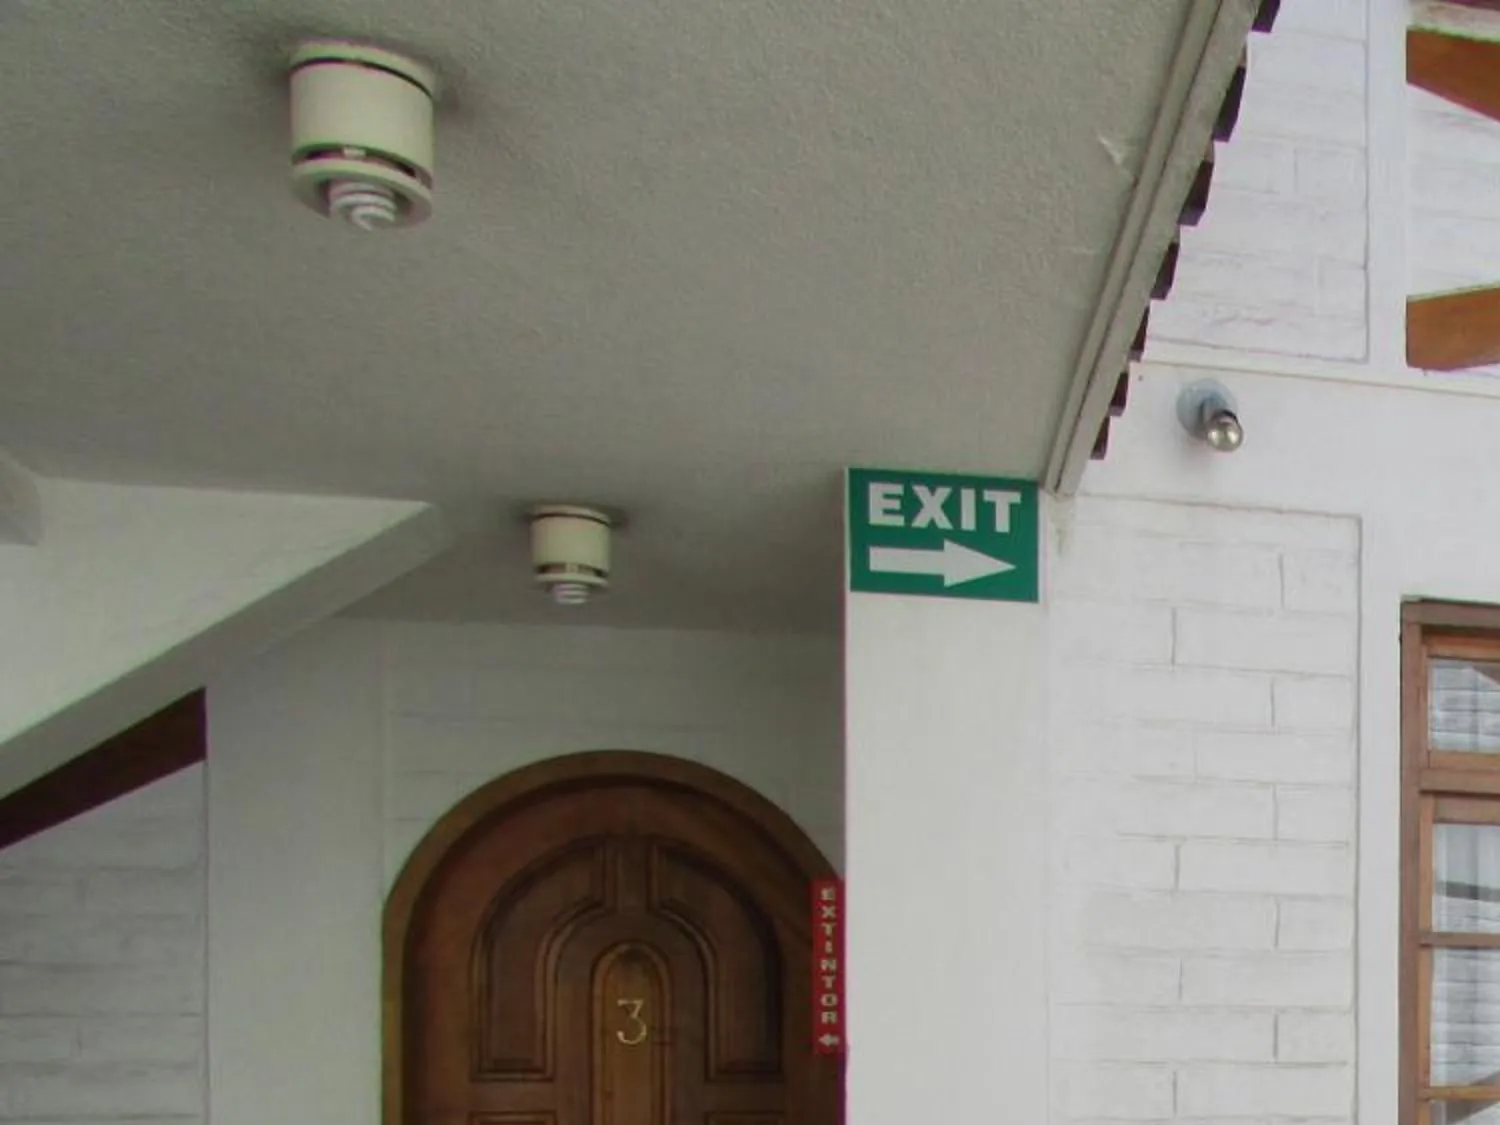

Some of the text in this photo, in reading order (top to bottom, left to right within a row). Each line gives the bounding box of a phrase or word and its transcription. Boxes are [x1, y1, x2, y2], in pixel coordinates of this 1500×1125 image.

[868, 481, 1021, 533] EXIT
[820, 887, 838, 1025] EXTINTOR
[616, 998, 647, 1045] 3
